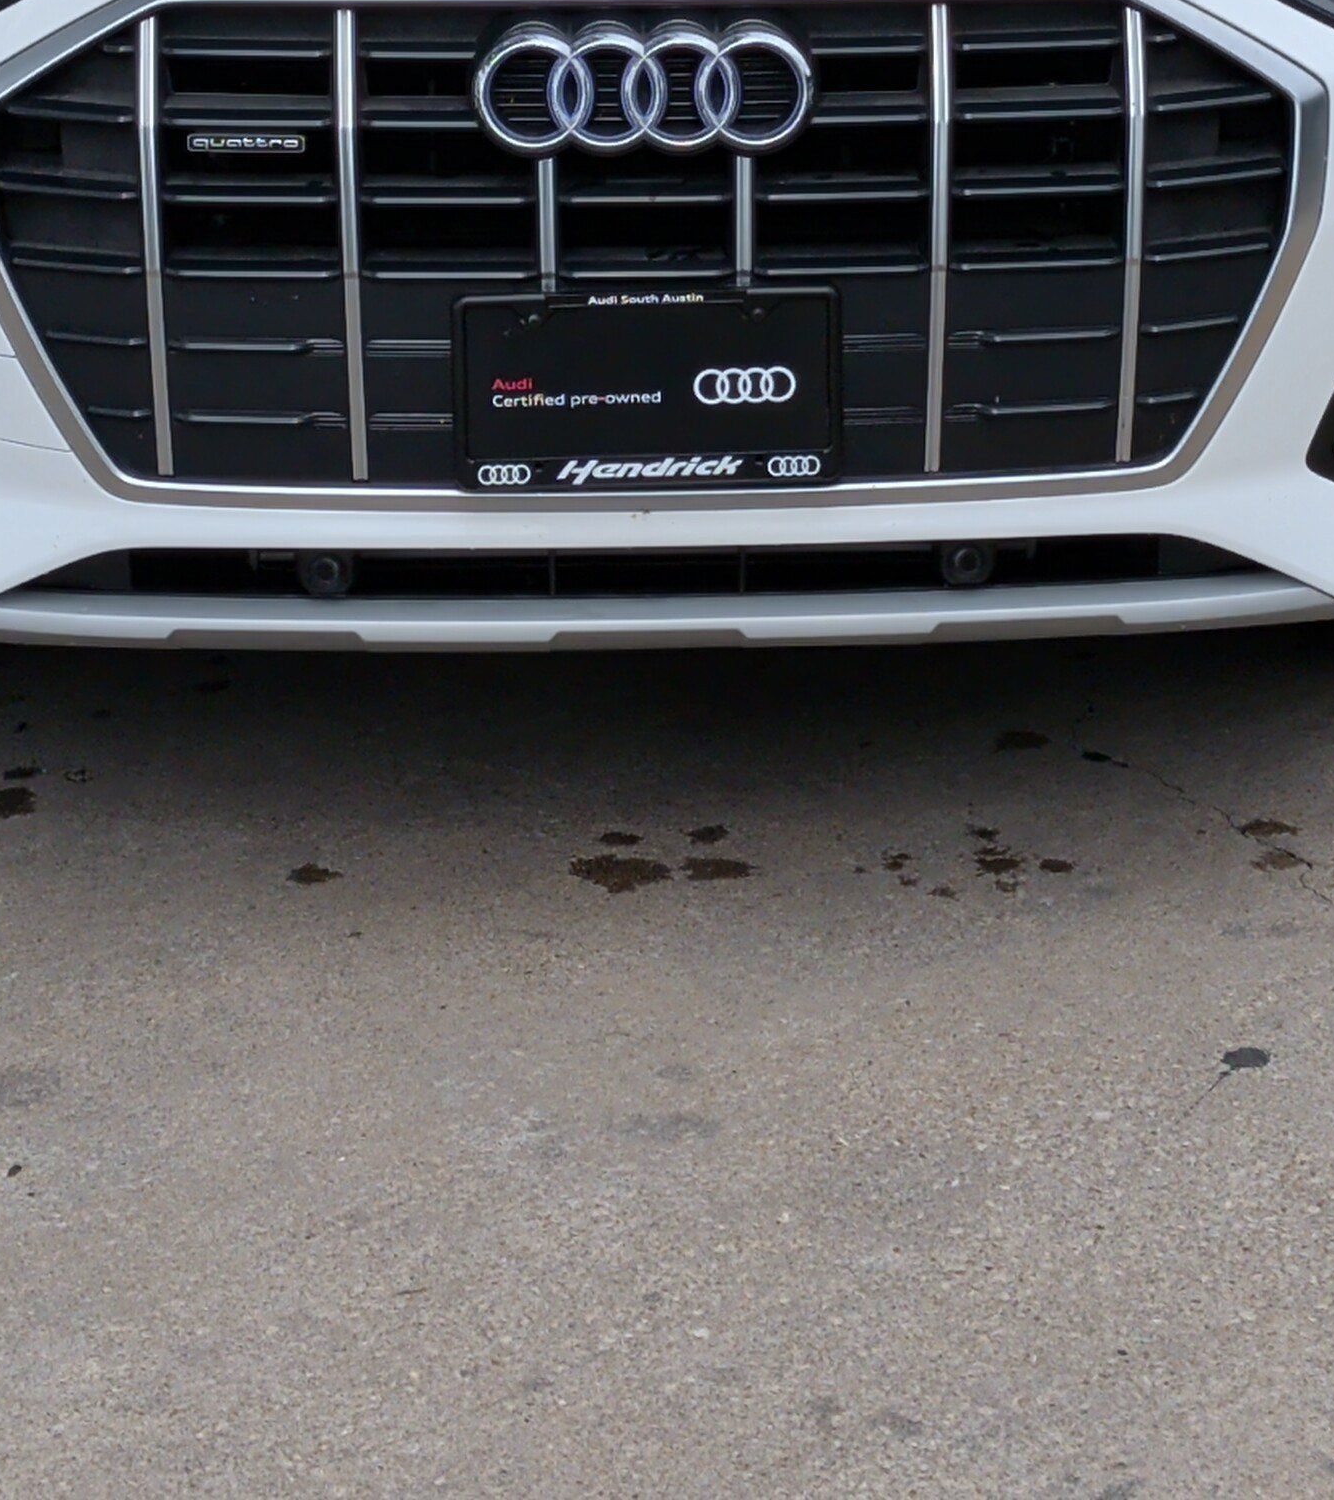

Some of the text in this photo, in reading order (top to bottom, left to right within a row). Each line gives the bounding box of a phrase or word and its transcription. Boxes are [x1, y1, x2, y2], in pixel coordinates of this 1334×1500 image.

[192, 137, 299, 150] quattro
[588, 292, 704, 305] Audi South Austin
[492, 378, 533, 390] Audi
[492, 391, 662, 409] Certified pre-owned
[556, 456, 743, 485] Hendrick
